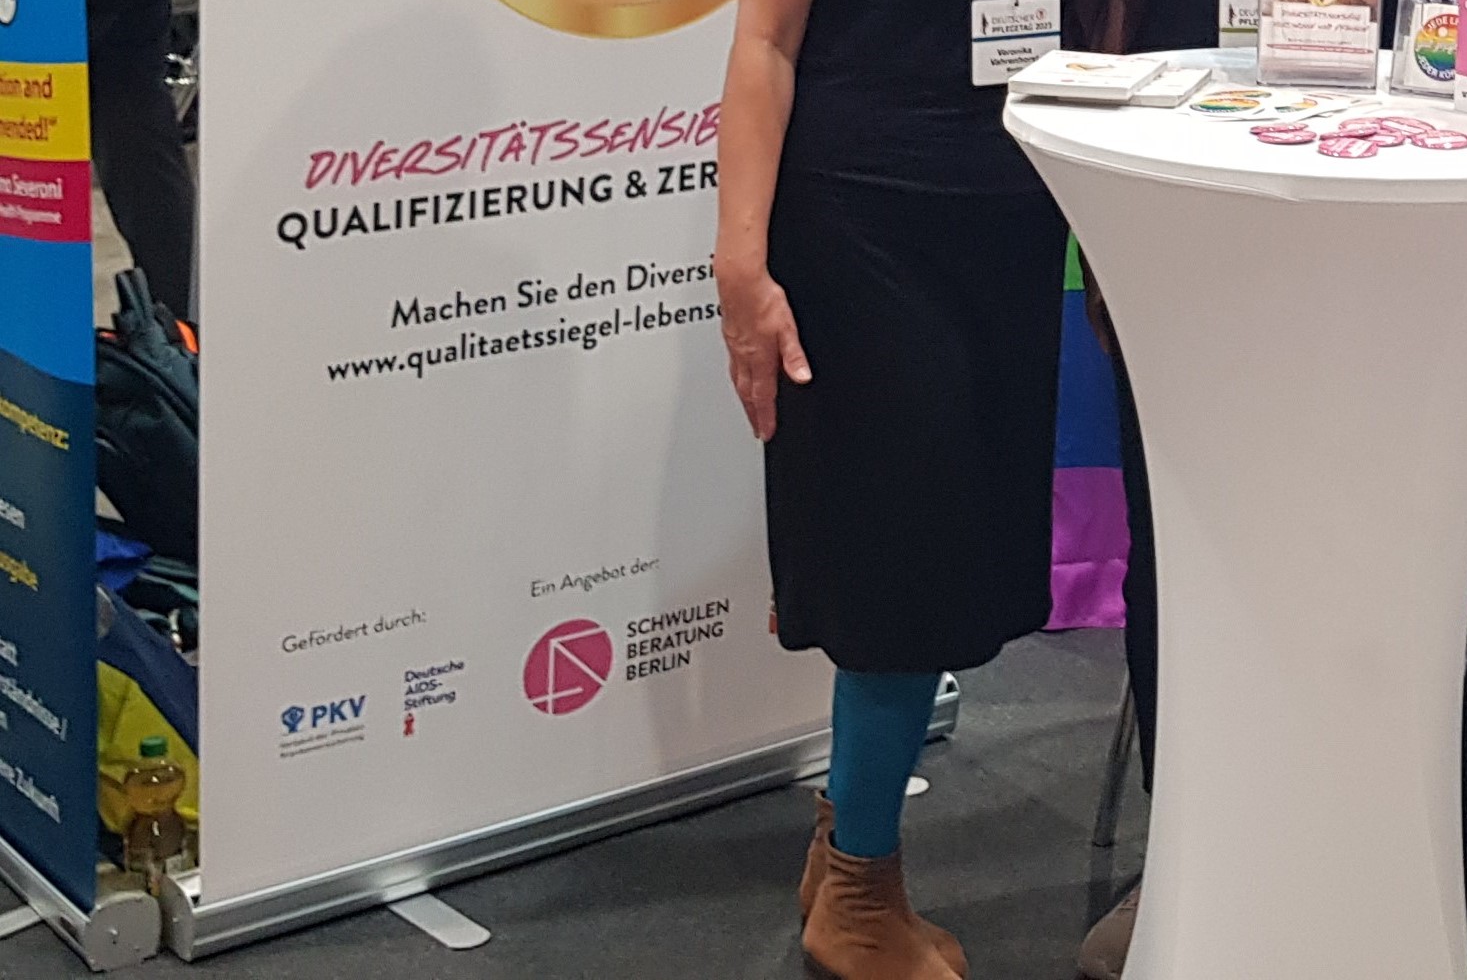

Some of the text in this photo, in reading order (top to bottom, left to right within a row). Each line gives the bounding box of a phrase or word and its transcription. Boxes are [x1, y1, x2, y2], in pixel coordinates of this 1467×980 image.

[24, 73, 53, 98] and
[276, 174, 613, 250] QUALIFIZIERUNG
[624, 170, 648, 199] &
[390, 291, 507, 328] Machen
[517, 279, 558, 309] Sie
[567, 272, 616, 300] den
[530, 579, 556, 598] Ein
[560, 565, 626, 592] Angebot
[282, 609, 427, 654] Gefördert durch:
[626, 598, 730, 638] SCHWULEN
[626, 622, 725, 660] BERATUNG
[404, 661, 465, 683] Deutsche
[625, 651, 691, 682] BERLIN
[311, 695, 366, 728] PKV
